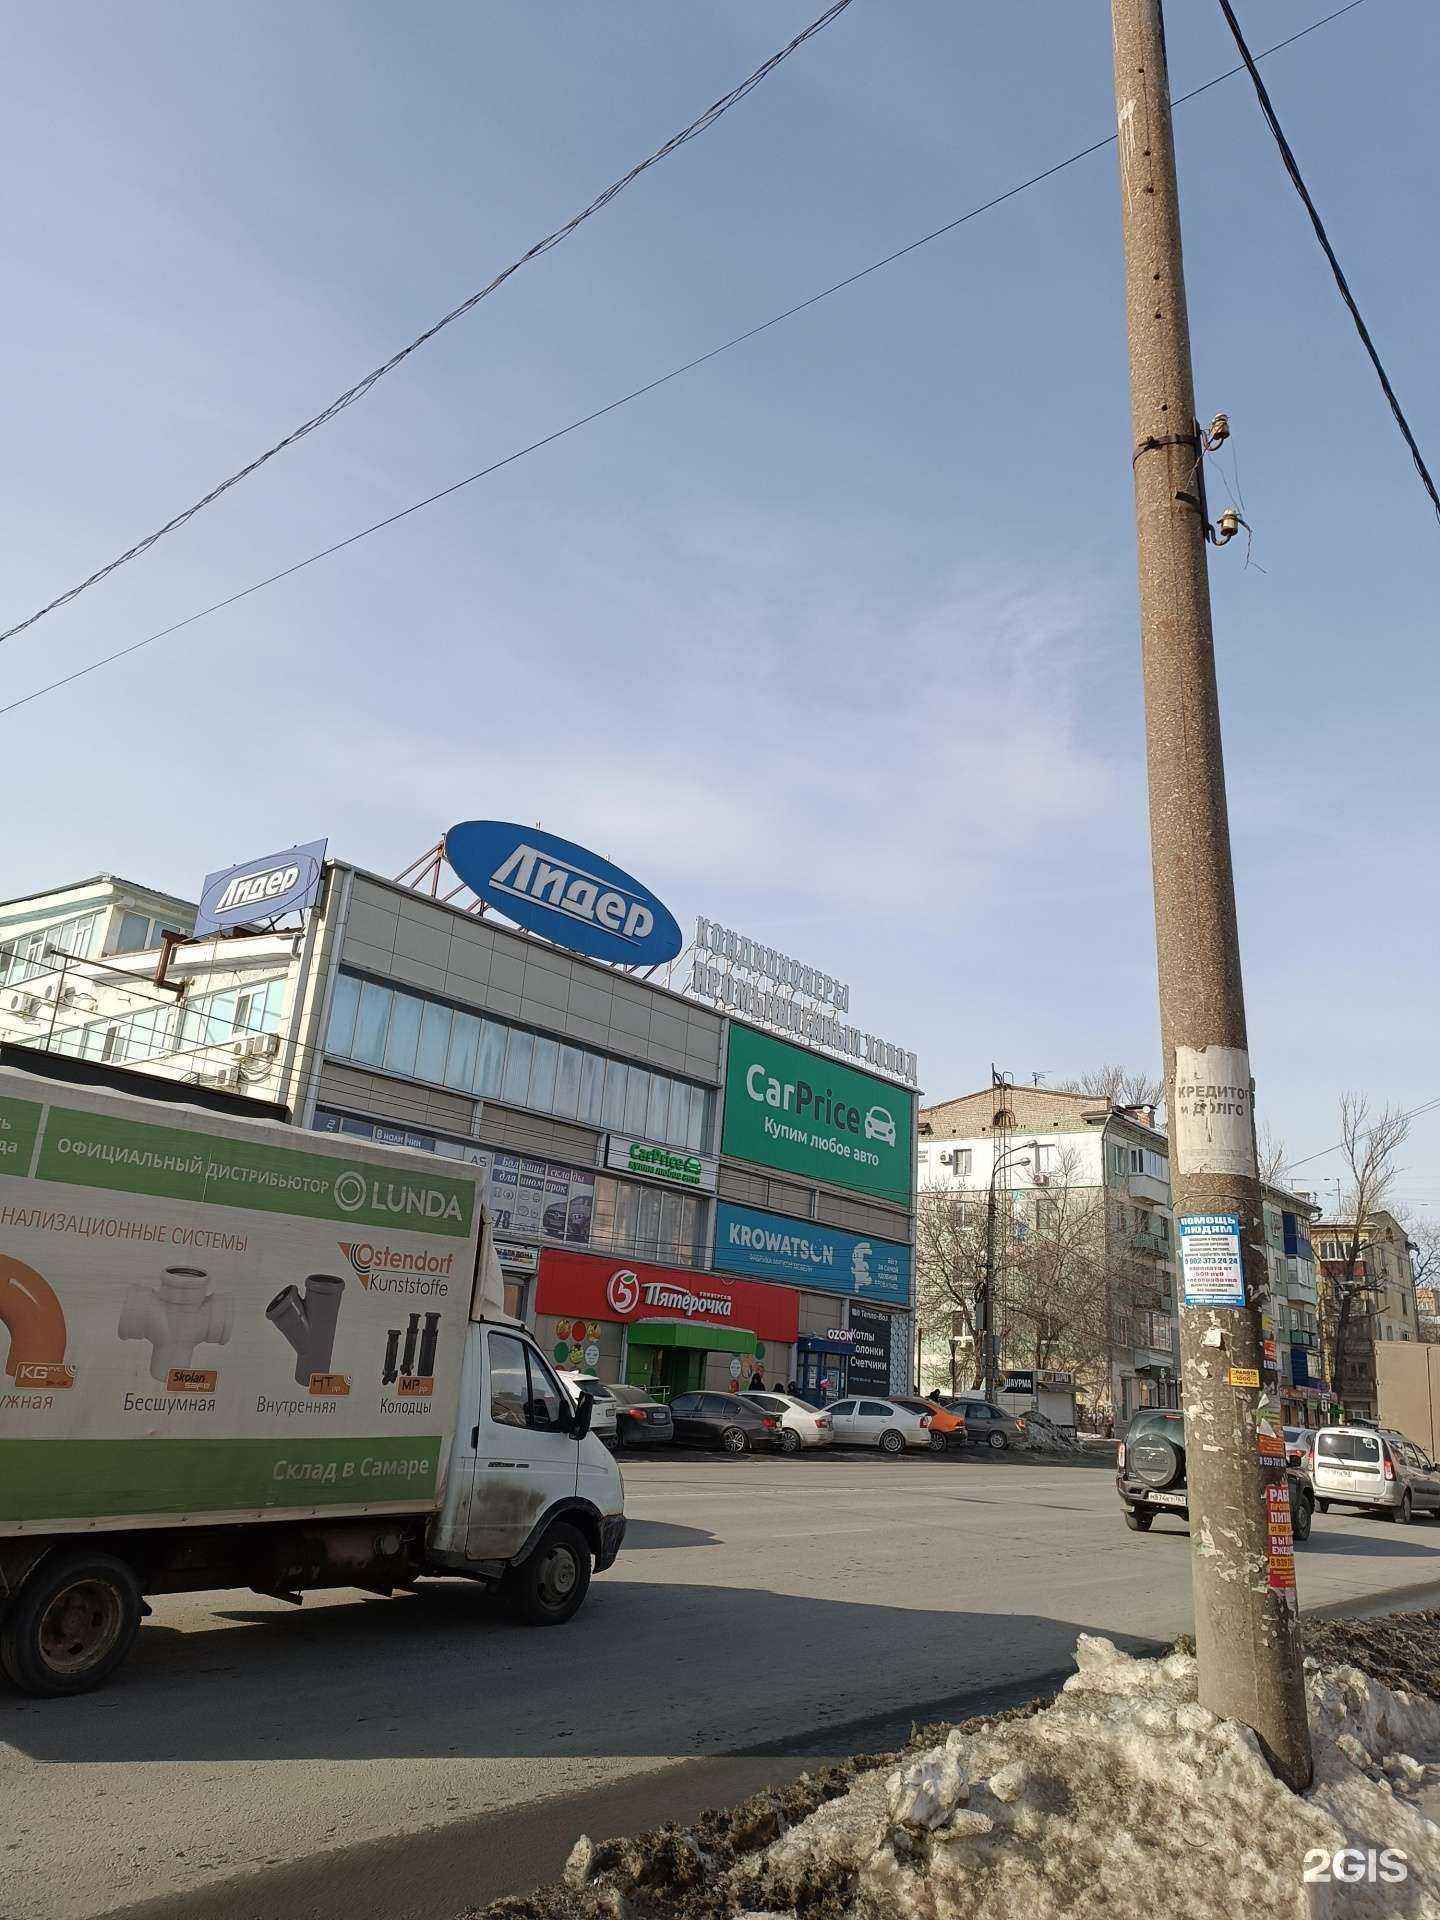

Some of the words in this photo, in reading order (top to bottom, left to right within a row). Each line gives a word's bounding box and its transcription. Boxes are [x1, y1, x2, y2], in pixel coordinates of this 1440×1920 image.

[216, 862, 299, 911] Лидер
[489, 844, 654, 938] Лидер
[746, 1064, 860, 1134] CarPrice
[764, 1116, 807, 1145] Купим
[810, 1134, 850, 1157] любое
[853, 1147, 879, 1167] авто
[57, 1138, 203, 1175] ОФИЦИАЛЬНЫЙ
[206, 1162, 329, 1194] ДИСТРИБЬЮТОР
[371, 1181, 463, 1221] LUNDA
[171, 1226, 249, 1252] СИСТЕМЫ
[357, 1243, 454, 1274] Ostendorf
[369, 1273, 449, 1297] Kunststoffe
[827, 1329, 853, 1342] OZON
[853, 1343, 884, 1357] олонки
[20, 1365, 49, 1380] KG
[850, 1356, 887, 1371] Счетчики
[173, 1370, 206, 1384] Skolan
[123, 1393, 217, 1416] Бесшумная
[256, 1395, 337, 1417] Внутренняя
[380, 1398, 432, 1416] Колодцы
[272, 1460, 337, 1483] Склад
[342, 1461, 355, 1479] в
[360, 1456, 430, 1481] Самаре
